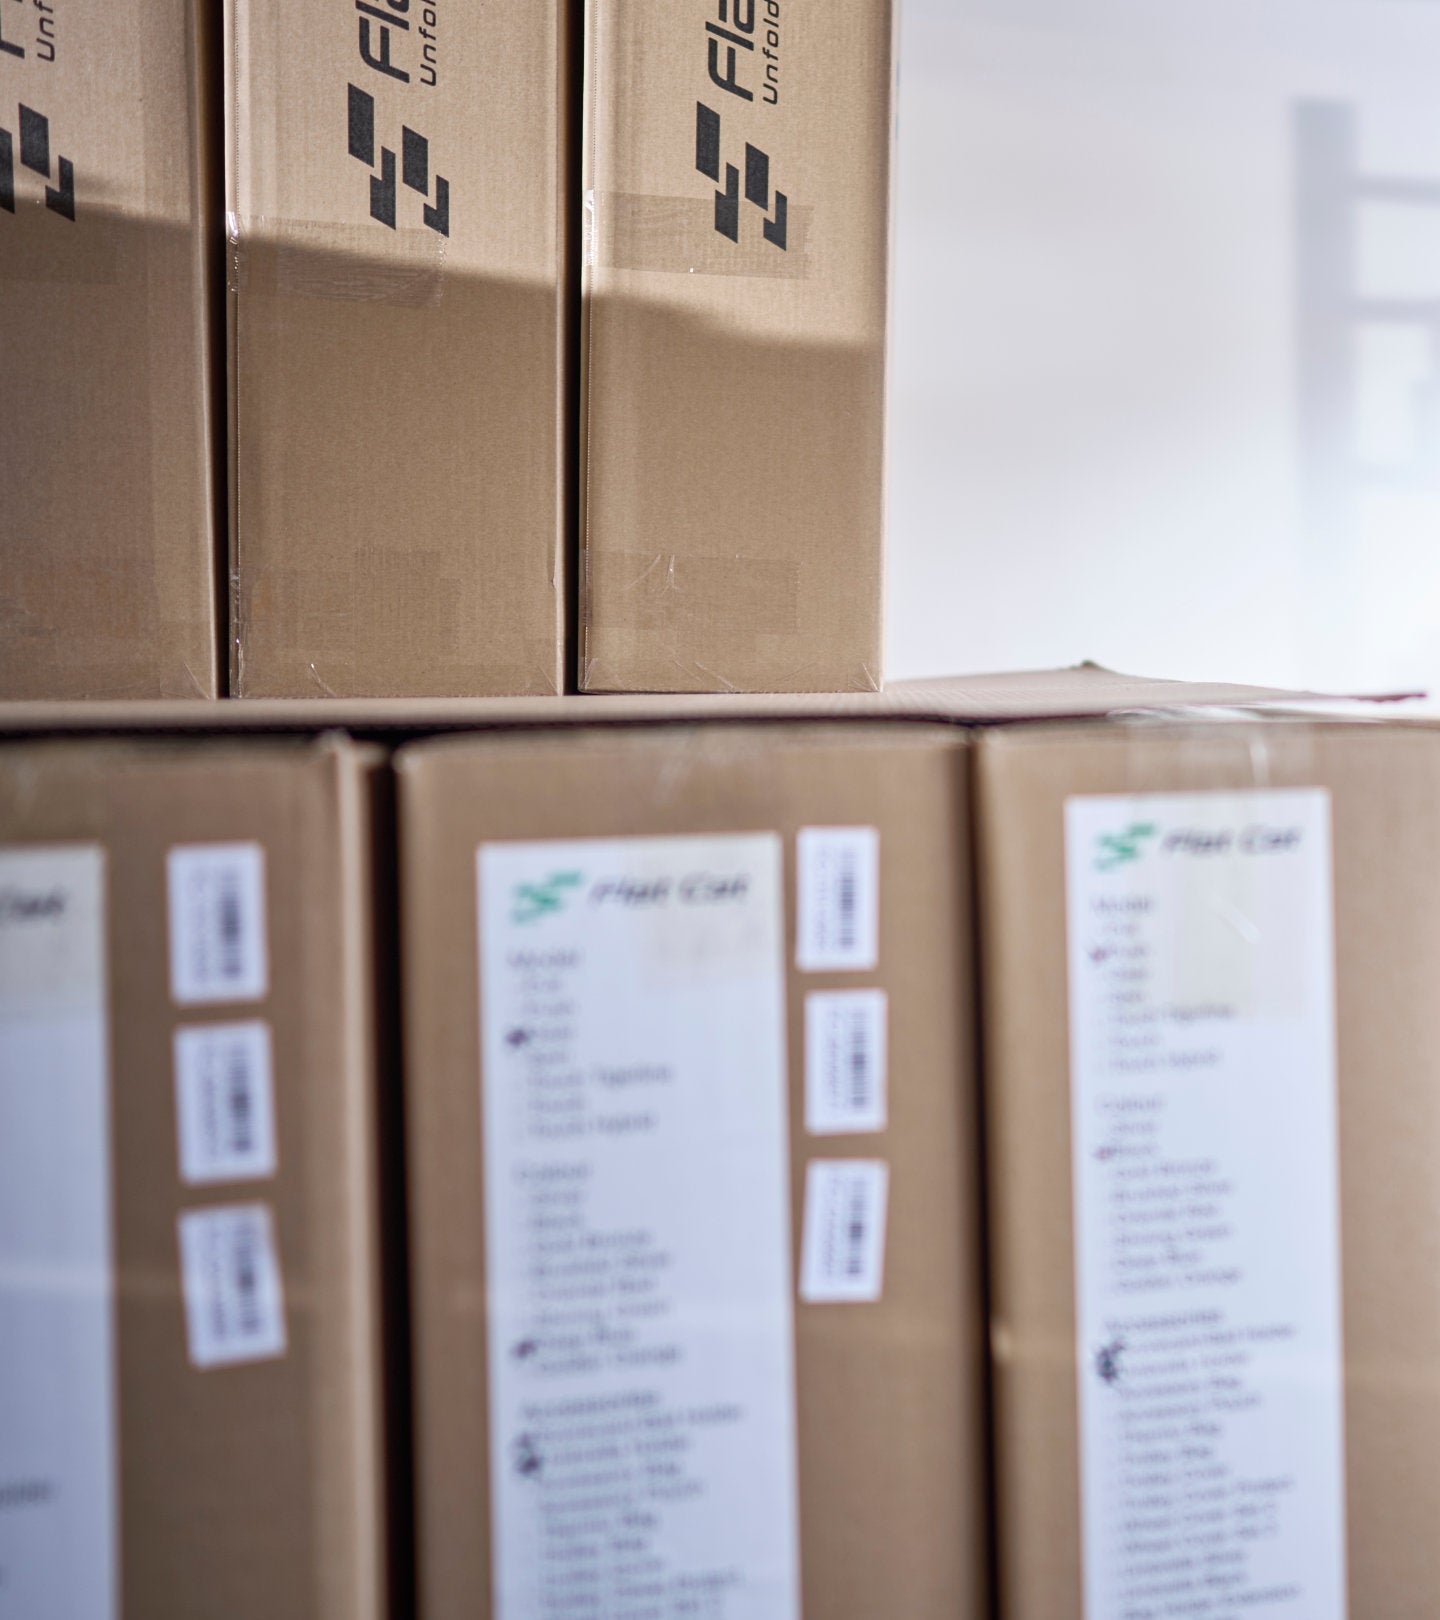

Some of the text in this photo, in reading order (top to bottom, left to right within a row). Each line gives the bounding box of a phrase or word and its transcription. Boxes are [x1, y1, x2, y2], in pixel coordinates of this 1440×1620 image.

[355, 0, 410, 84] Fl
[1161, 824, 1304, 856] Flat Cat
